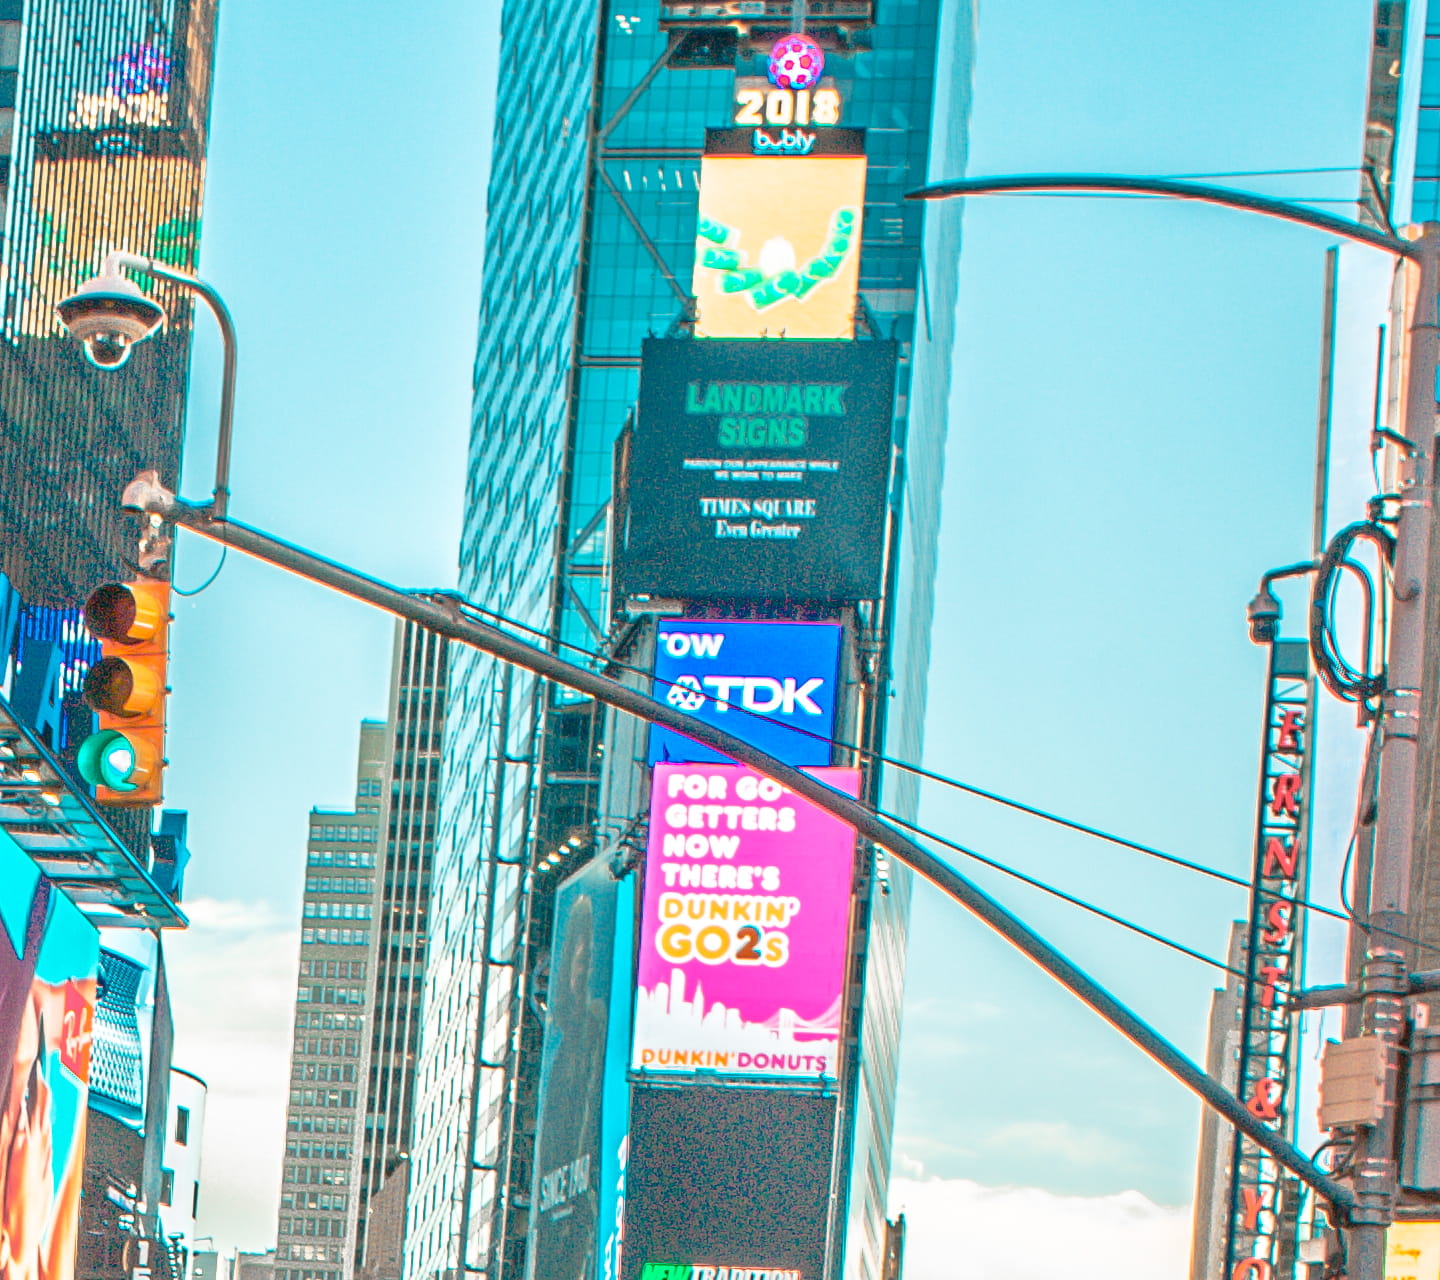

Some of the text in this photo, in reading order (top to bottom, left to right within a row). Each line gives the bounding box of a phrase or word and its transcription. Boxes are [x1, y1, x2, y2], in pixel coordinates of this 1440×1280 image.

[736, 88, 840, 126] 2018
[686, 382, 846, 417] LANDMARK
[719, 416, 806, 448] SIGNS
[699, 497, 817, 520] TIMES SQUARE
[715, 520, 802, 540] Even Greater
[660, 633, 724, 660] OW
[704, 676, 824, 715] TDK
[667, 774, 727, 799] FOR
[664, 806, 796, 832] GETTERS
[662, 833, 740, 859] NOW
[1259, 710, 1306, 1008] ERNST
[661, 863, 781, 891] THERE'S
[661, 896, 800, 922] DUNKIN'
[641, 1047, 828, 1072] DUNKIN' DONUTS
[1247, 1075, 1283, 1119] &
